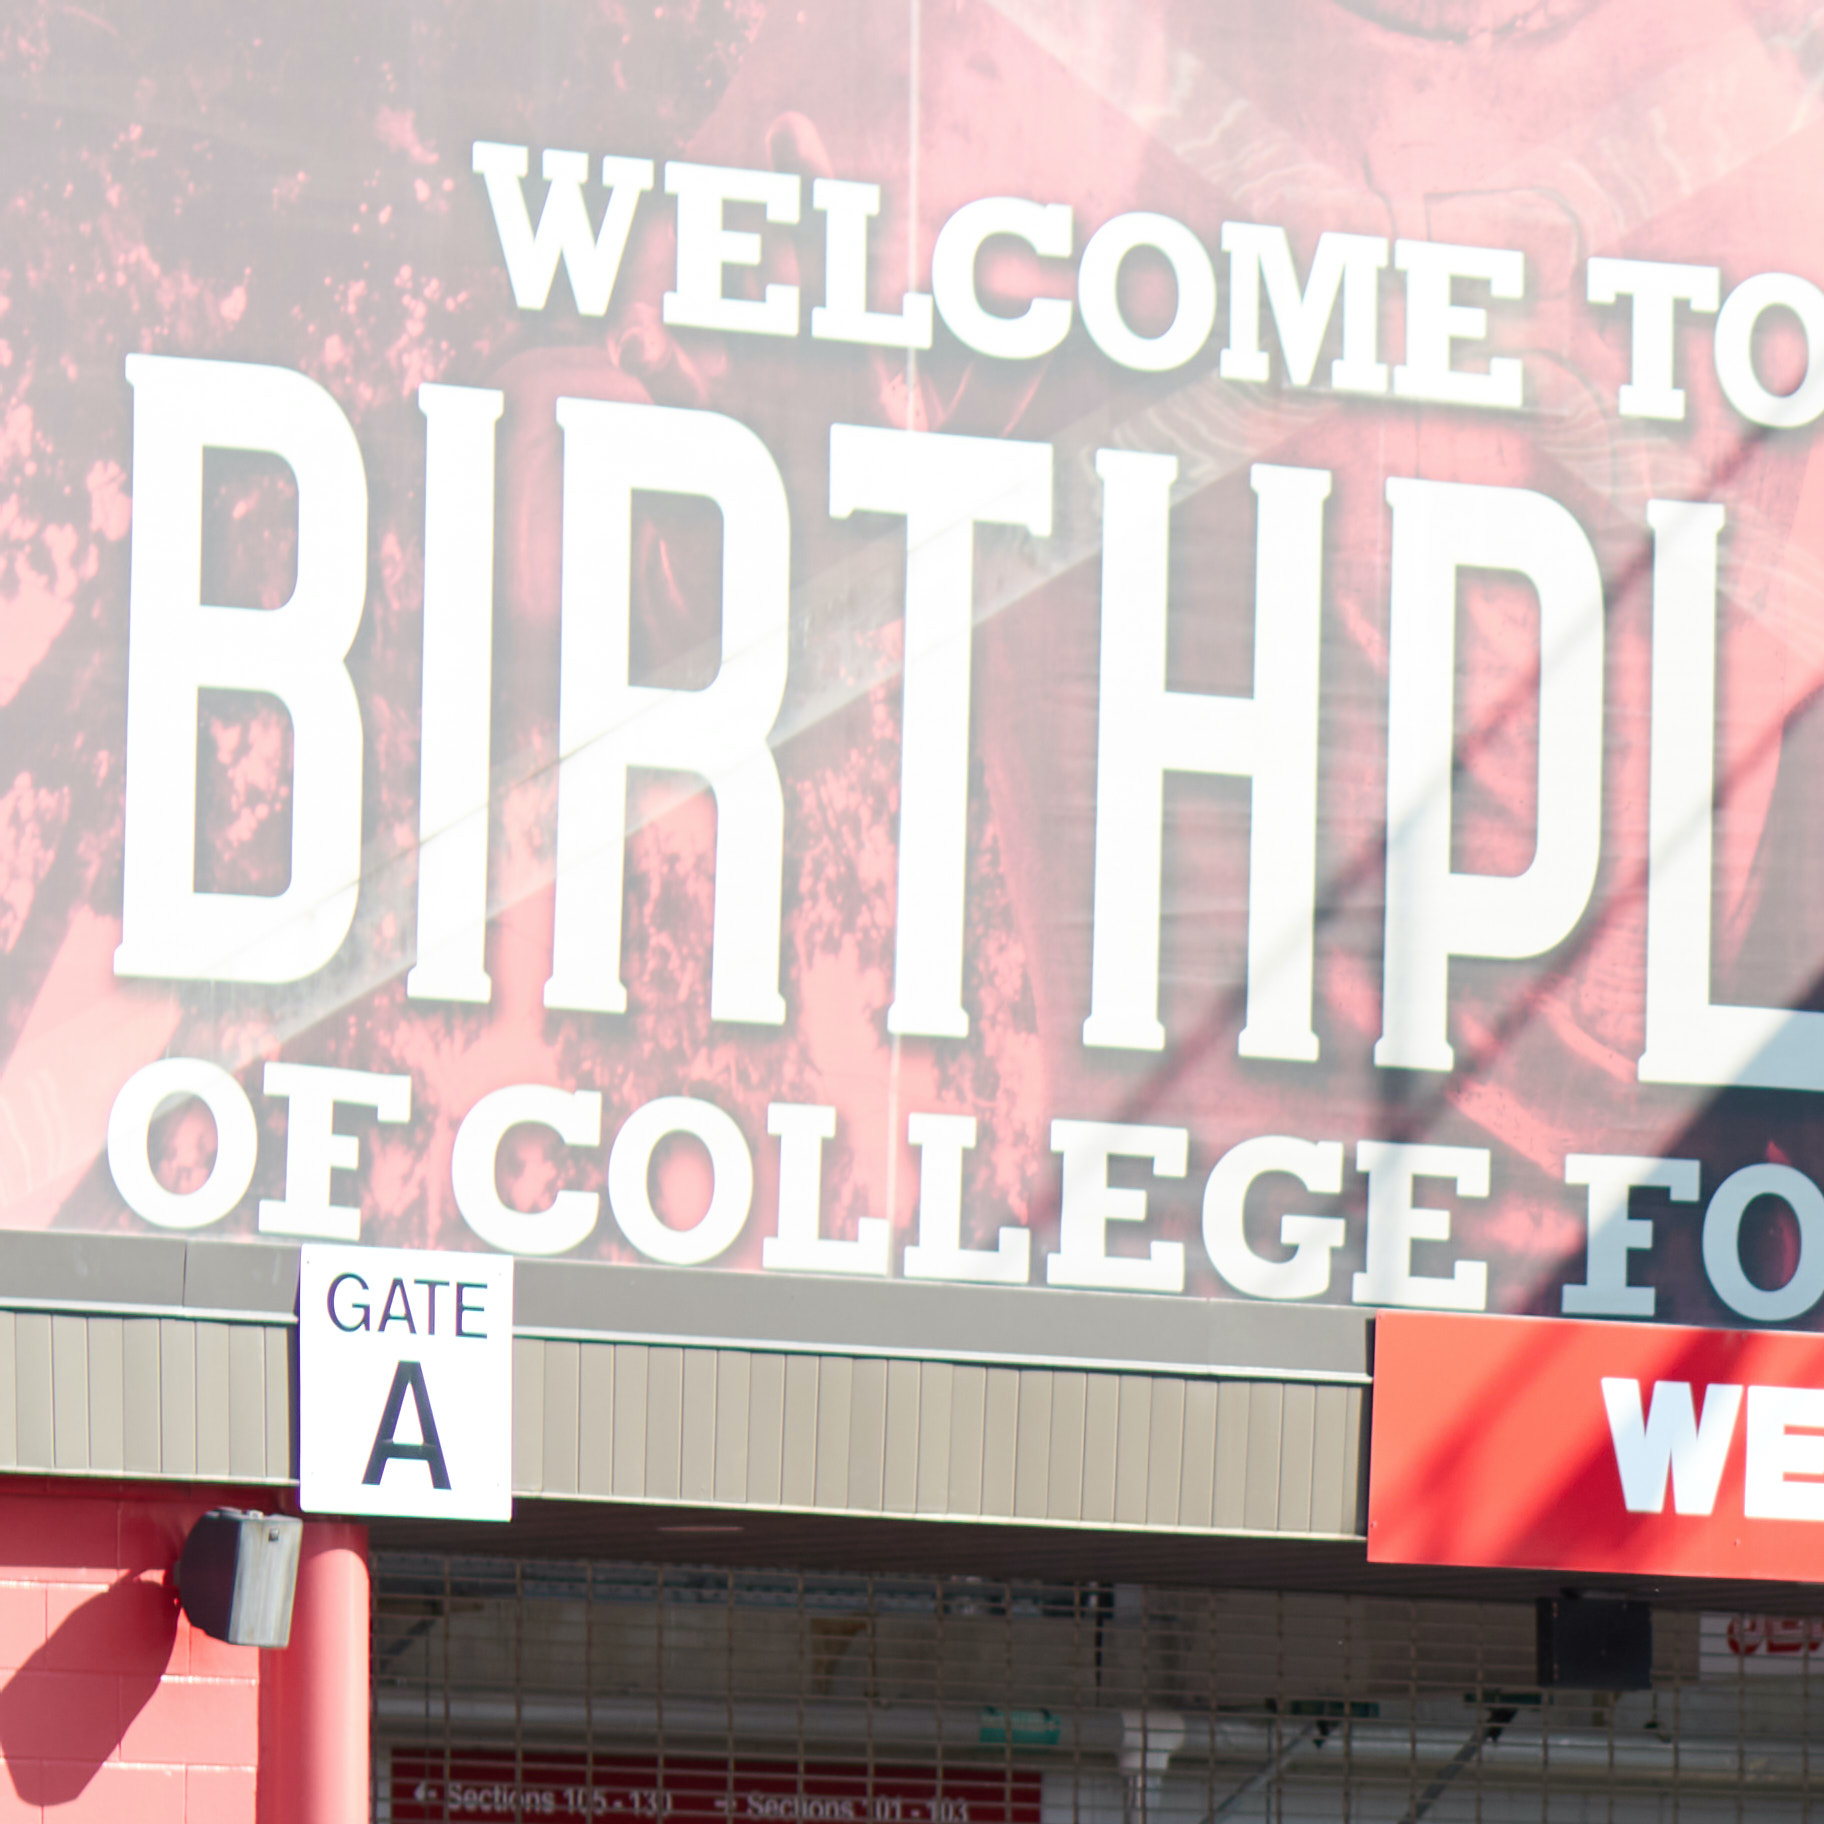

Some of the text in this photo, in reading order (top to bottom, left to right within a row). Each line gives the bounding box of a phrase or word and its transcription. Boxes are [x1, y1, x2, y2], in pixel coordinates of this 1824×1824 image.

[472, 141, 1524, 408] WELCOME
[107, 1057, 411, 1240] OF
[451, 1083, 1490, 1312] COLLEGE
[325, 1272, 488, 1340] GATE
[361, 1361, 452, 1490] A
